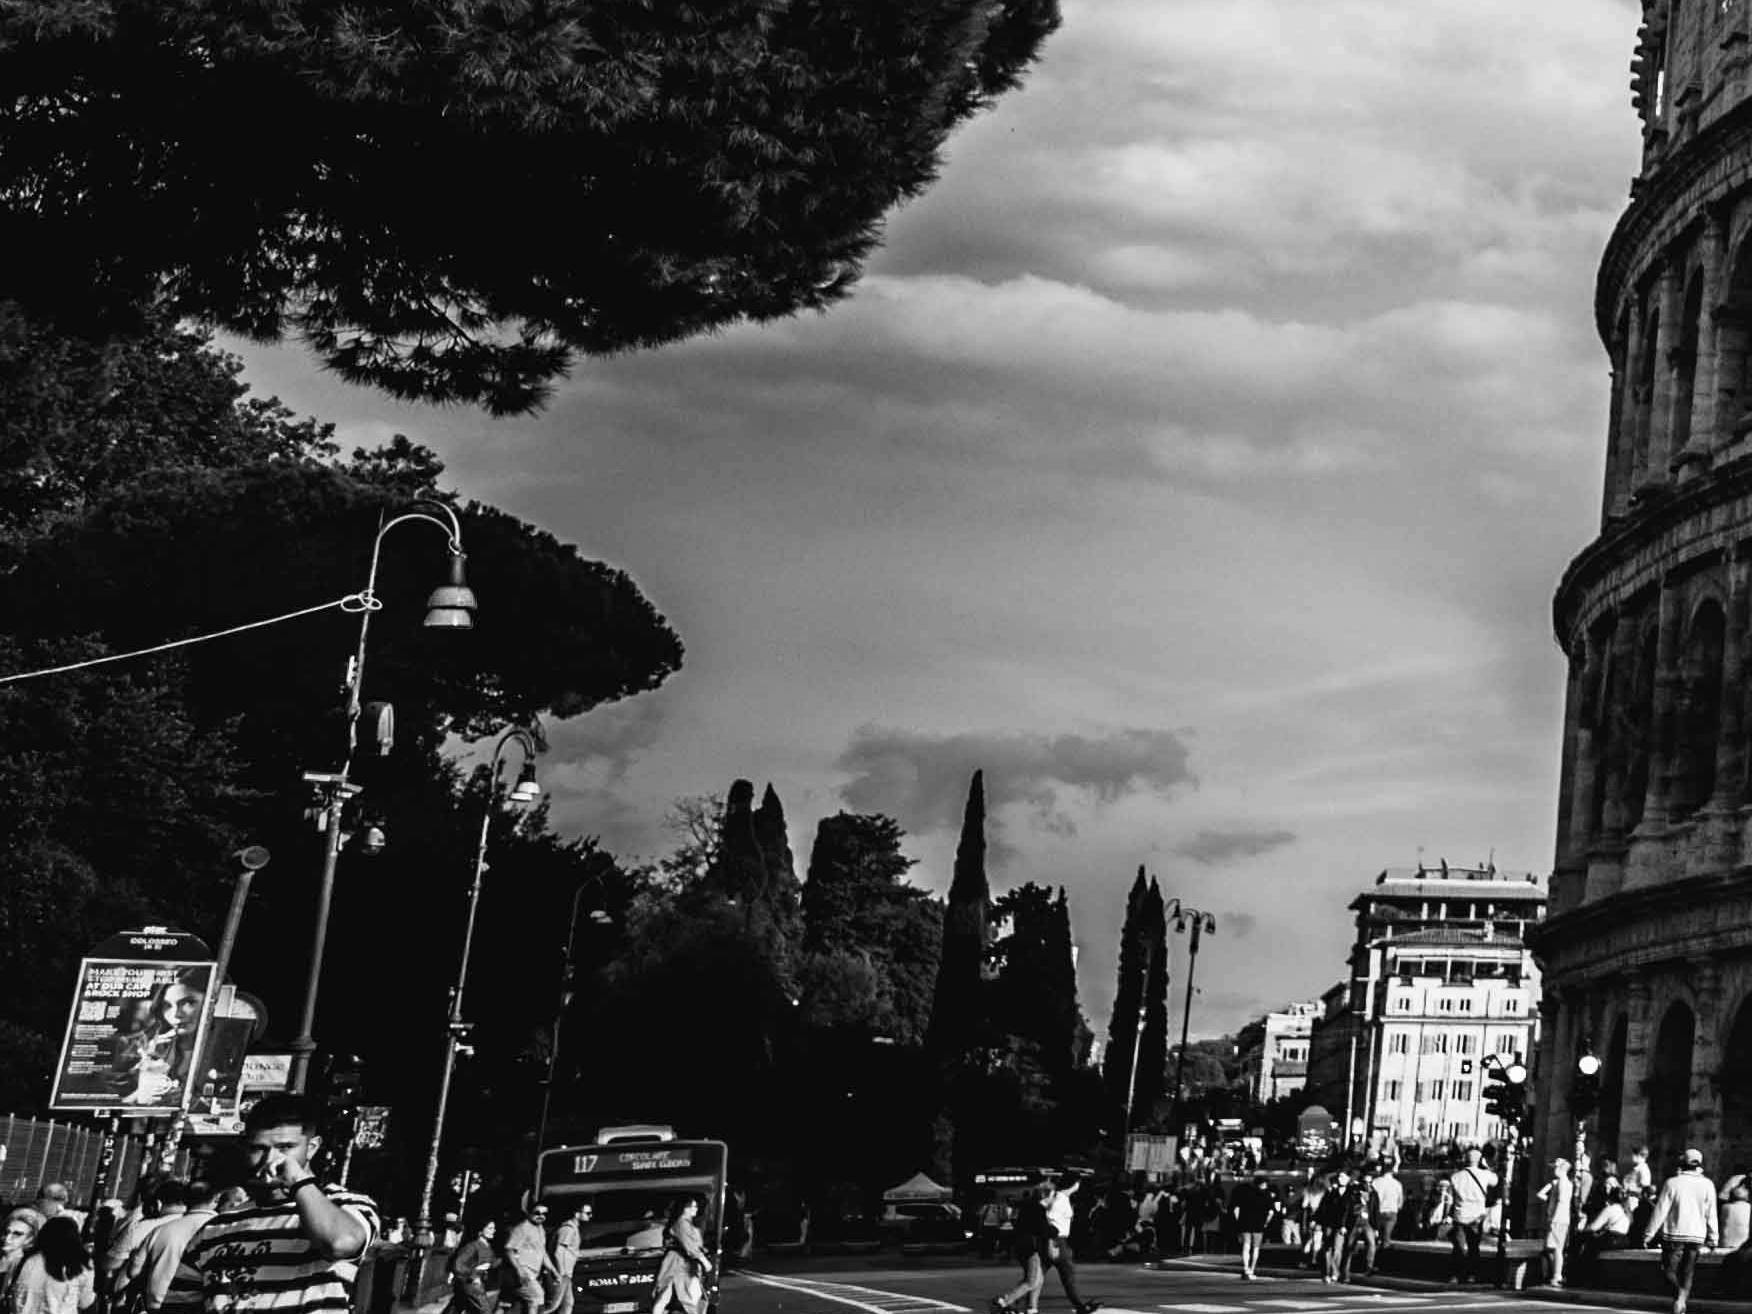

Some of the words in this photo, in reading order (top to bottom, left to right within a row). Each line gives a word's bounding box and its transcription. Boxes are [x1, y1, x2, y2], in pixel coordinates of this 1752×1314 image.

[130, 937, 179, 946] COLOSSEO
[86, 982, 101, 990] AT
[101, 982, 124, 991] OUR
[573, 1154, 600, 1174] 117
[588, 1278, 619, 1287] ROMA
[629, 1274, 655, 1285] atac
